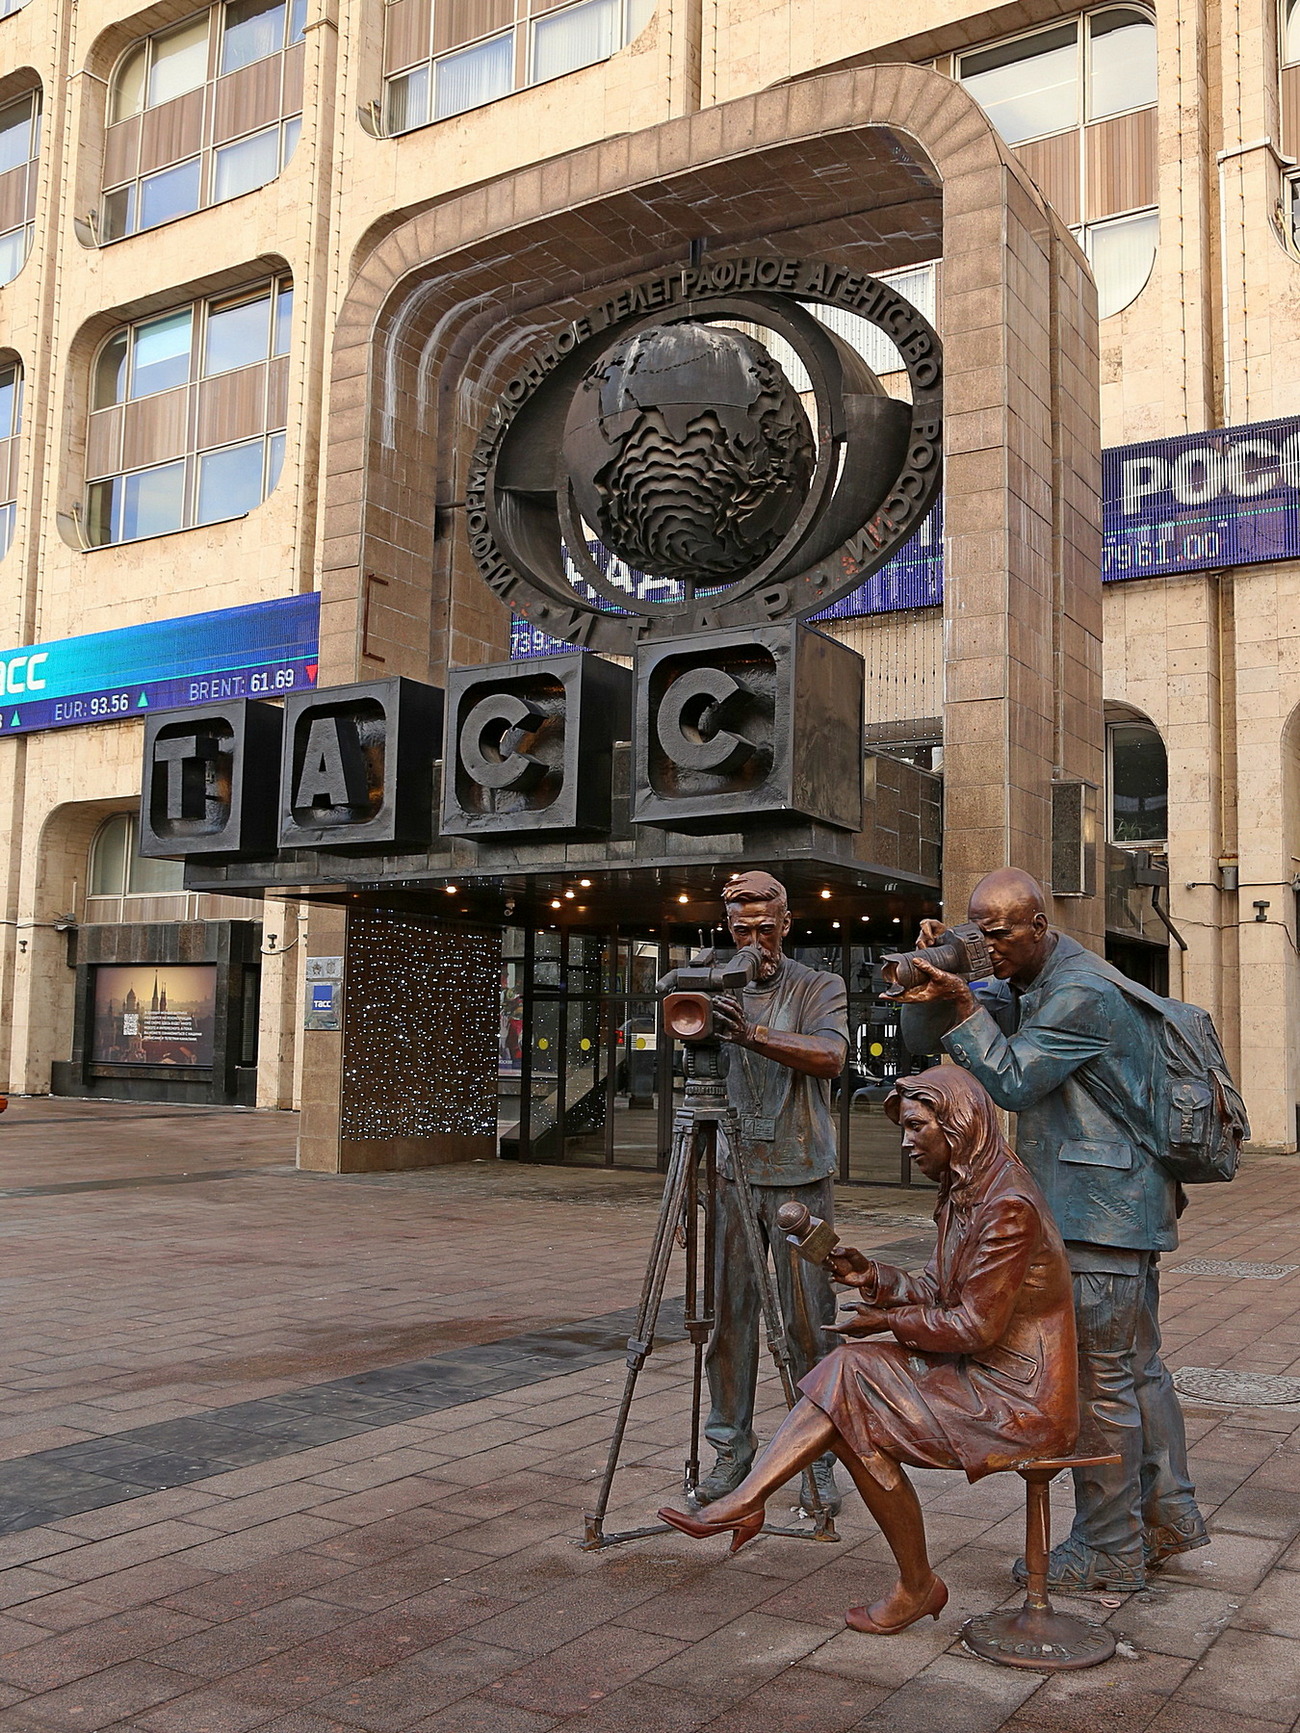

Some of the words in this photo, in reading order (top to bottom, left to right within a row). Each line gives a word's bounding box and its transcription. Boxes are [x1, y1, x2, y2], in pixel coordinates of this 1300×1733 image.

[598, 257, 799, 326] ТЕЛЕГРАФНОЕ
[806, 263, 939, 388] АГЕНТСТВО
[466, 315, 593, 598] ИНФОРМАЦИОННОЕ
[844, 419, 940, 565] РОССИИ
[55, 700, 88, 721] EUR:
[90, 693, 129, 716] 93.56
[154, 666, 740, 820] ТАСС
[190, 676, 245, 701] BRENT:
[251, 668, 295, 692] 61.69
